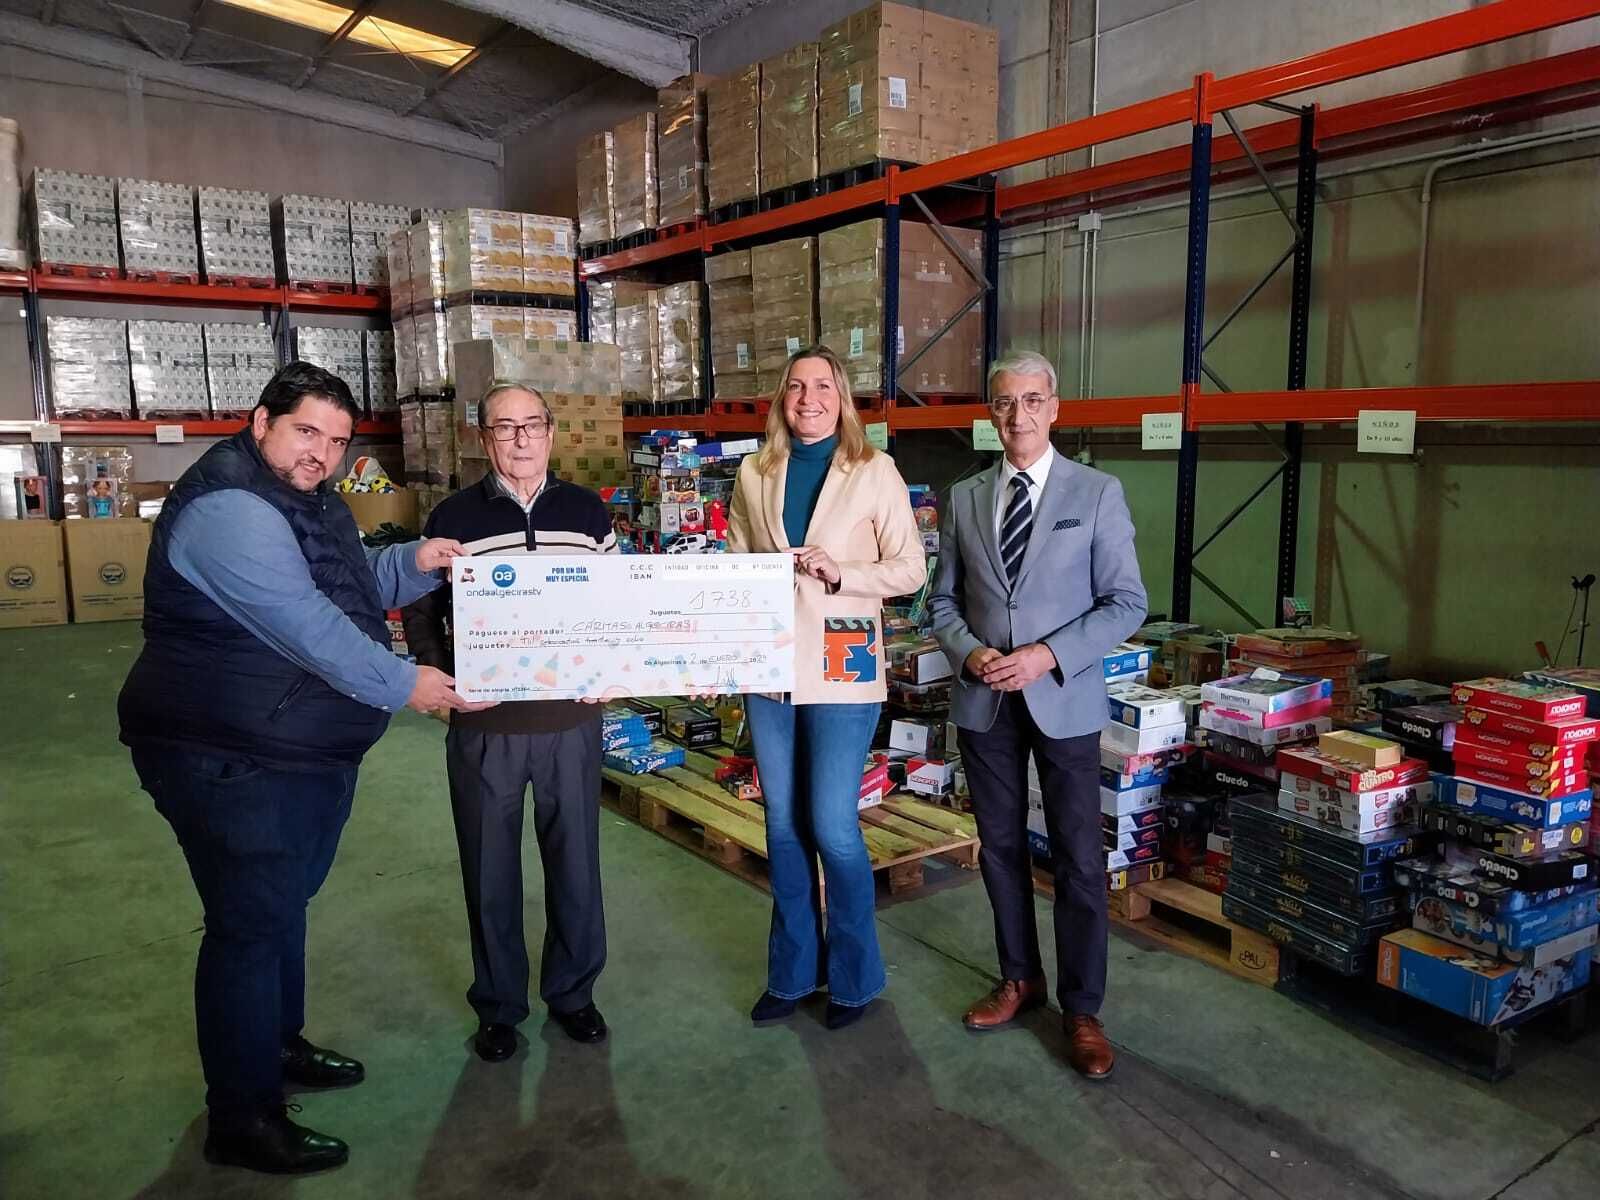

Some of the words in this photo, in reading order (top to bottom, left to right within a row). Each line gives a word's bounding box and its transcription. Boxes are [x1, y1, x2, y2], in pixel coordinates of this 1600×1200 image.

[576, 566, 587, 574] DÍA
[466, 587, 542, 598] ondaalgecirastv
[1402, 720, 1432, 738] Cluedo
[1216, 772, 1248, 788] Cluedo
[1480, 858, 1519, 880] Cluedo
